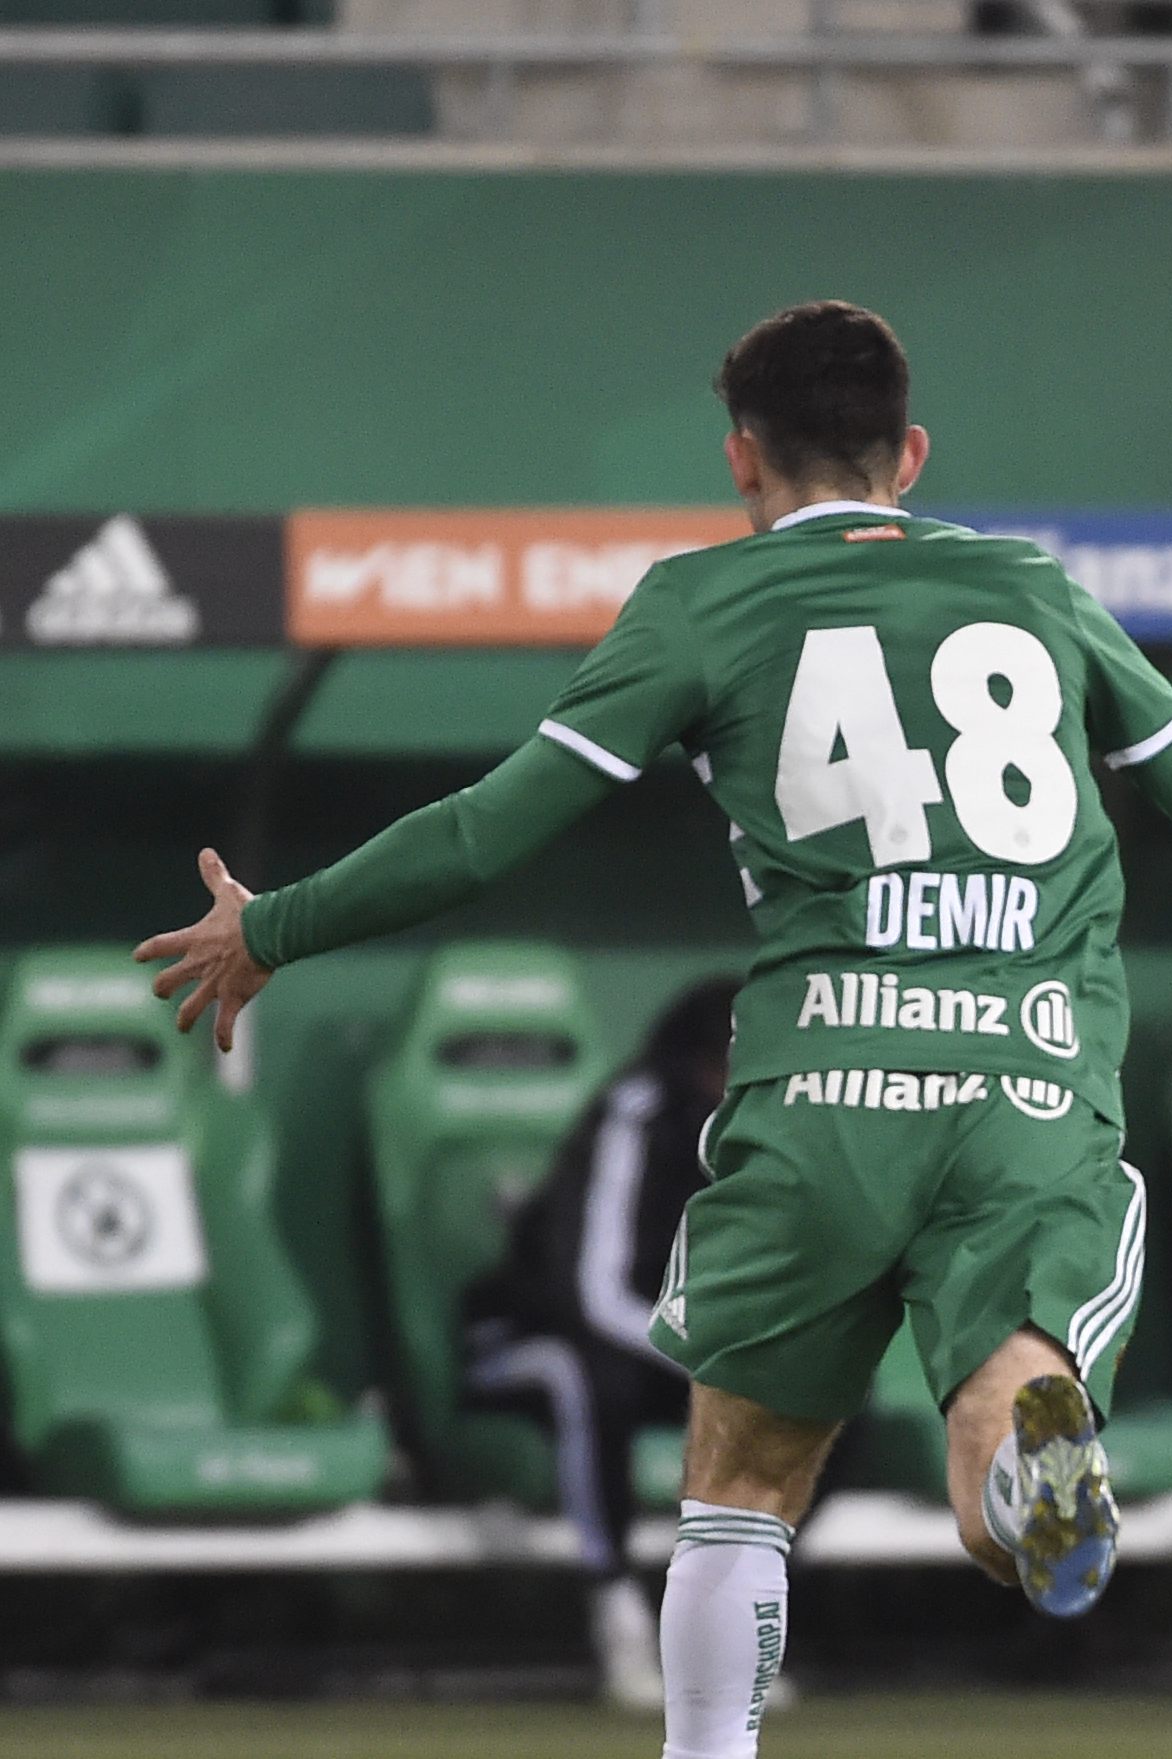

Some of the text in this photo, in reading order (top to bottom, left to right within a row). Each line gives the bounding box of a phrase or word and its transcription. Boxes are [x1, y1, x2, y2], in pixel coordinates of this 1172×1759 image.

[774, 621, 1078, 868] 48
[865, 871, 1038, 952] DEMIR
[797, 972, 1010, 1036] Allianz
[746, 1600, 781, 1731] RAPIDSHOP.AT
